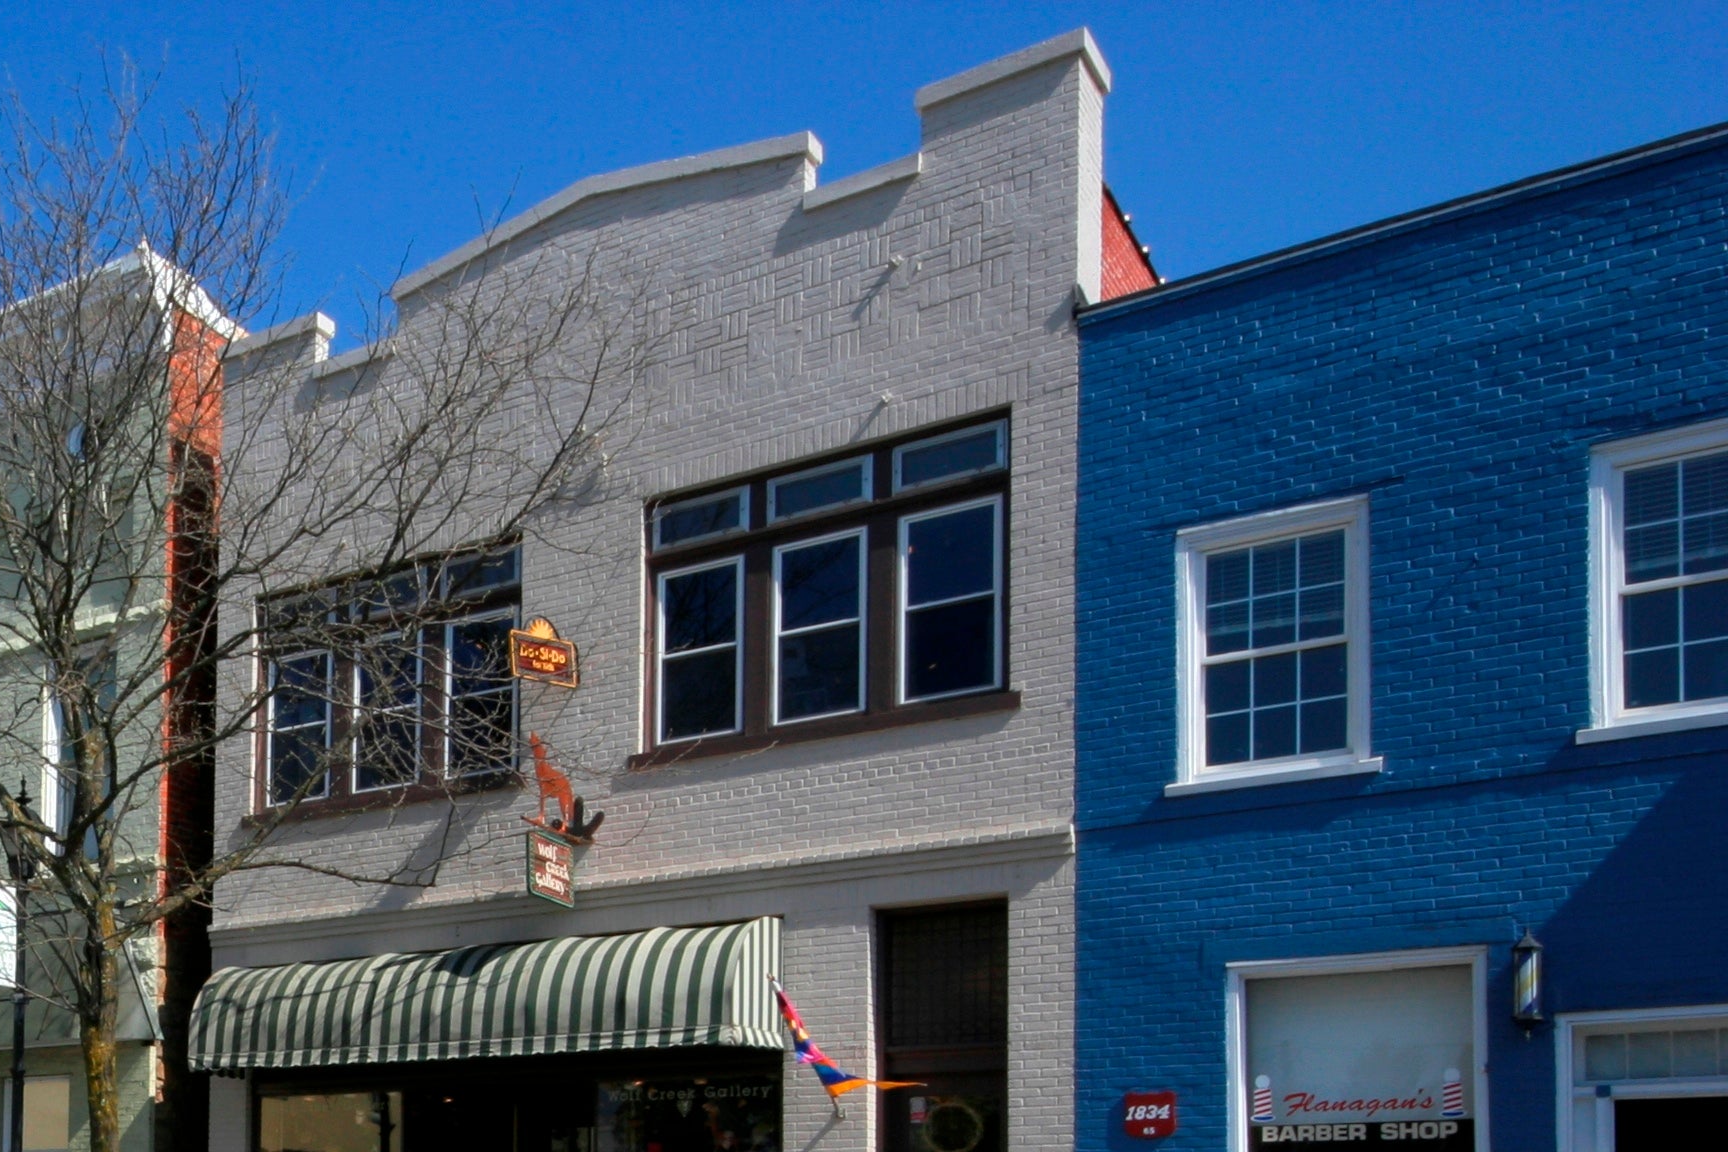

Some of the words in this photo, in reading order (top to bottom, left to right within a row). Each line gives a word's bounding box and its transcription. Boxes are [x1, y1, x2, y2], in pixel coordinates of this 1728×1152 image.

[609, 1087, 643, 1101] Wolf
[648, 1088, 695, 1100] Creek
[704, 1085, 772, 1098] Gallery
[1283, 1088, 1434, 1117] Flanagan's
[1125, 1104, 1170, 1120] 1834
[1262, 1123, 1367, 1143] BARBER
[1380, 1121, 1458, 1140] SHOP
